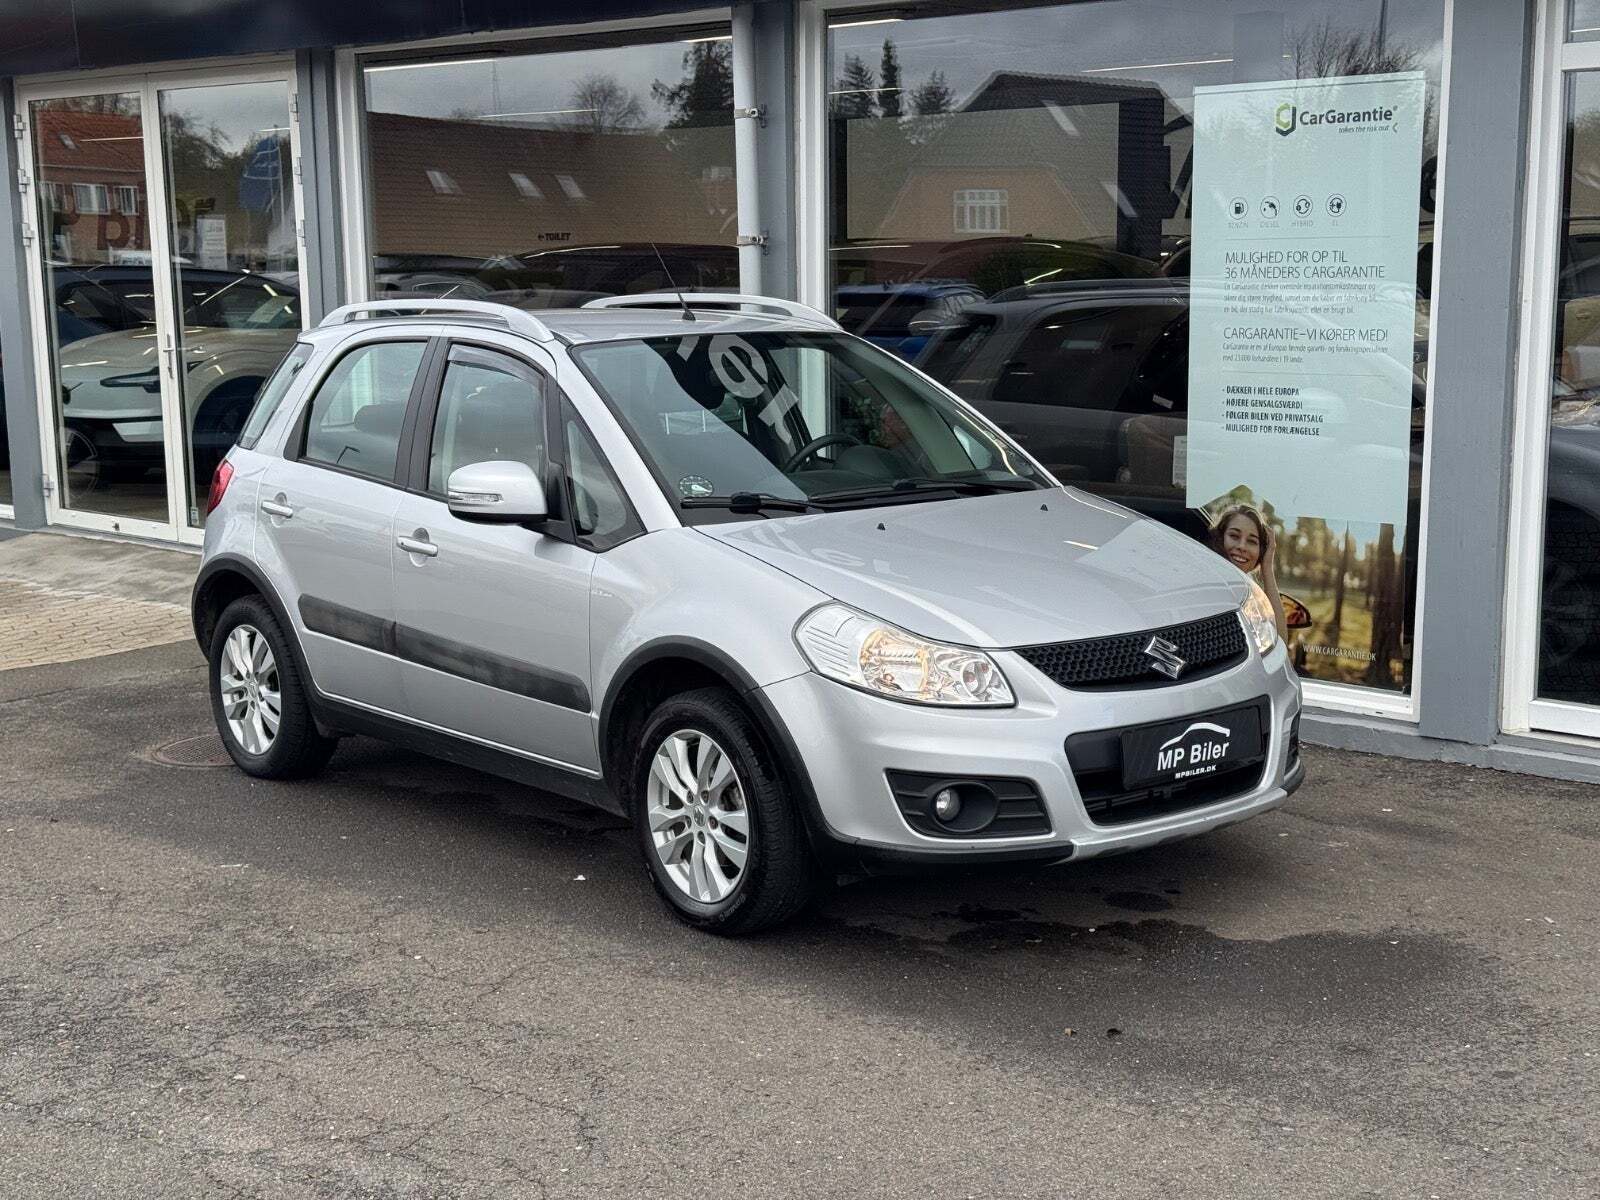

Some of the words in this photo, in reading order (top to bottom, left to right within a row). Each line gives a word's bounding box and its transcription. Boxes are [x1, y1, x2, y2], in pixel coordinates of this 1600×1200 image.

[1300, 106, 1393, 126] CarGarantie
[545, 232, 571, 241] TOILET
[1225, 251, 1283, 264] MULIGHED
[1287, 251, 1309, 263] FOR
[1312, 251, 1328, 263] OP
[1333, 250, 1348, 263] TIL
[1225, 267, 1237, 279] 36
[1240, 264, 1300, 279] MÅNEDERS
[1303, 266, 1385, 279] CARGARANTIE
[1319, 328, 1356, 341] KØRER
[1226, 385, 1251, 395] DÆKKER
[1257, 387, 1273, 395] HELE
[1275, 387, 1300, 396] EUROPA
[1226, 399, 1249, 408] HØJERE
[1250, 400, 1303, 409] GENSALGSVÆRDI
[1225, 411, 1249, 420] FØLGER
[1250, 412, 1268, 421] BILEN
[1271, 413, 1283, 422] VED
[1284, 414, 1324, 423] PRIVATSALG
[1225, 424, 1258, 433] MULIGHED
[1259, 425, 1273, 433] FOR
[1273, 426, 1320, 436] FORLÆNGELSE
[1302, 644, 1376, 661] WWW.CARGARANTIE.DK
[1157, 748, 1185, 771] MP
[1189, 741, 1230, 764] Biler
[1175, 765, 1217, 779] MPBILER.DK
